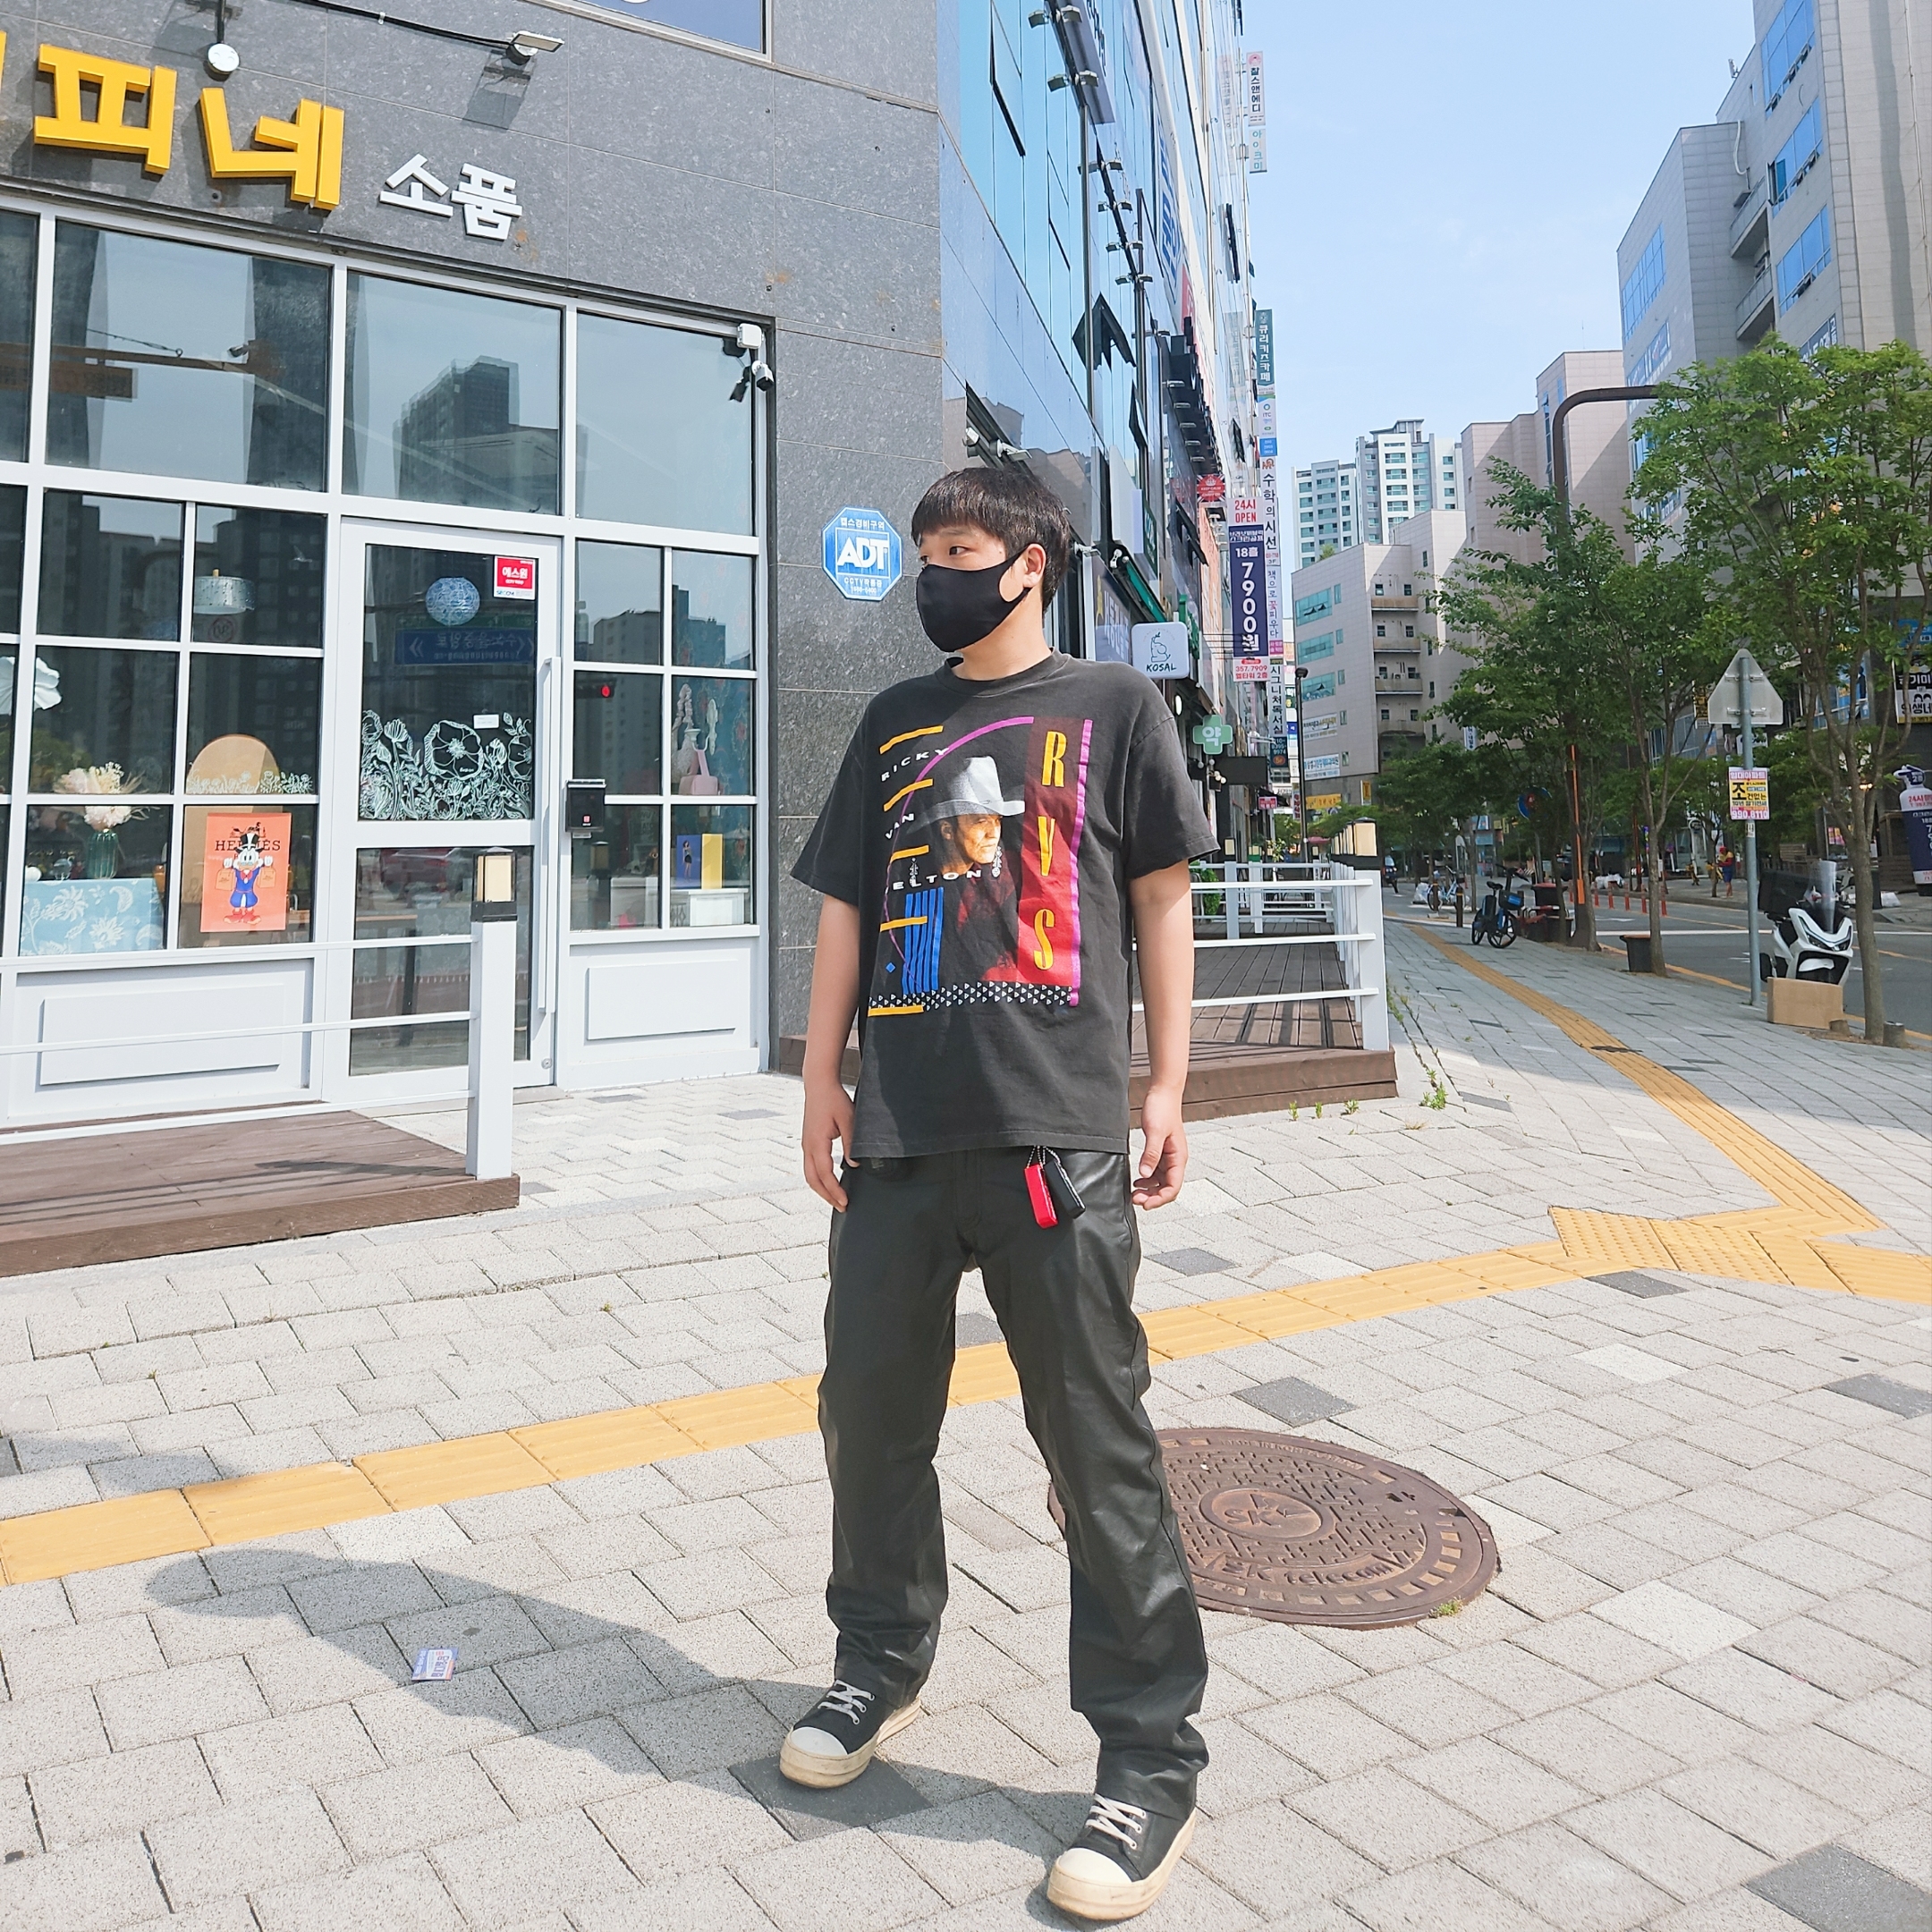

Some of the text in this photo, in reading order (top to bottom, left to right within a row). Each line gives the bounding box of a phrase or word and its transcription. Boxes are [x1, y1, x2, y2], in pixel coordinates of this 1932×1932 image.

[0, 30, 522, 242] 피네 소품
[1258, 325, 1270, 382] 큐리키즈카페
[1234, 499, 1256, 511] 24시
[1263, 473, 1276, 549] 수학의시선
[1235, 512, 1257, 523] OPEN
[837, 537, 889, 570] ADT
[1235, 547, 1258, 558] 18홀
[1147, 663, 1177, 673] KOSAL
[1270, 665, 1283, 734] 시그니처독서실
[1202, 726, 1222, 747] 약
[881, 747, 949, 782] RICKY
[1732, 809, 1768, 820] 990.8110
[886, 813, 914, 839] VAN
[1224, 1507, 1274, 1529] SK
[1284, 1563, 1394, 1585] telecom
